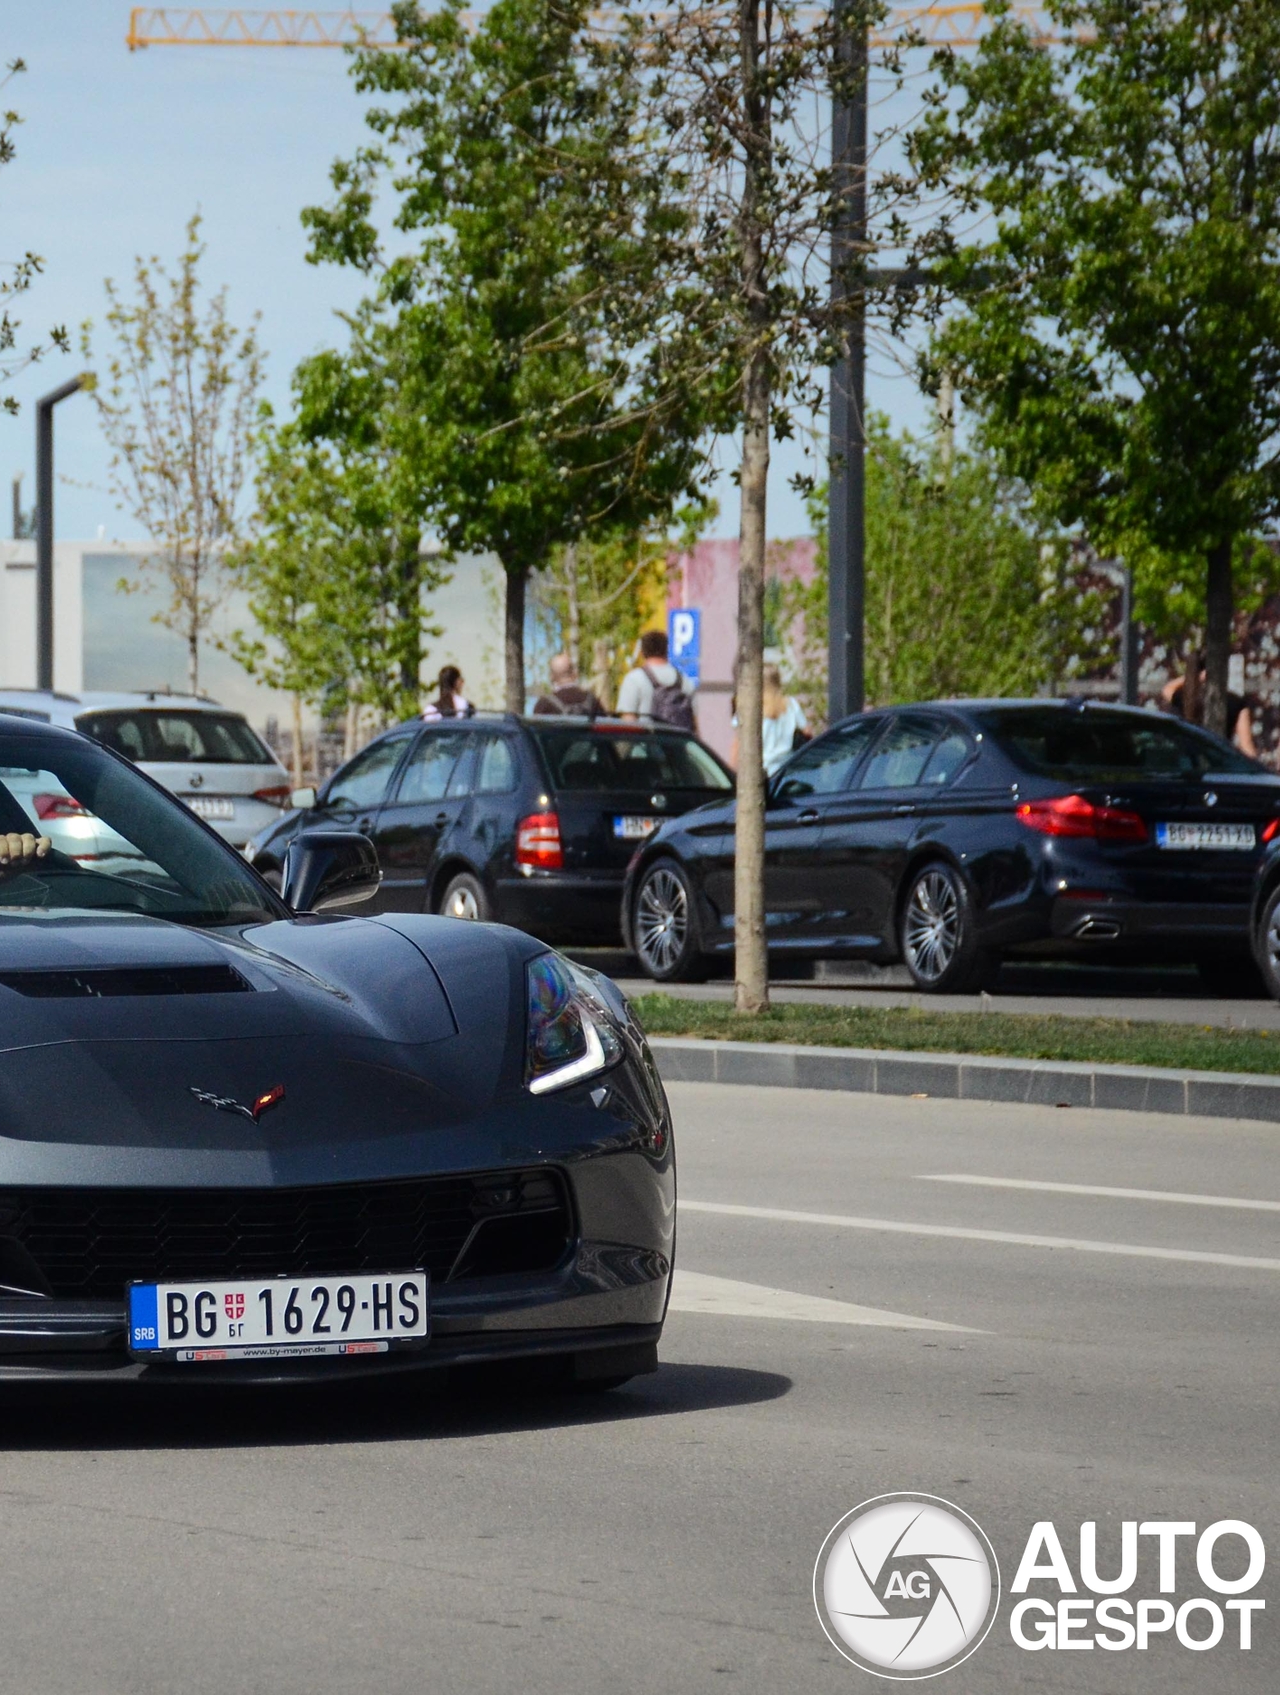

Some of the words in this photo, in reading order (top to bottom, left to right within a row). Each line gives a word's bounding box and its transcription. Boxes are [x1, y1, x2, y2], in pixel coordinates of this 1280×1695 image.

[673, 612, 694, 656] P
[166, 1290, 218, 1340] BG
[134, 1327, 156, 1341] SRB
[243, 1346, 326, 1358] www.by-mayer.de
